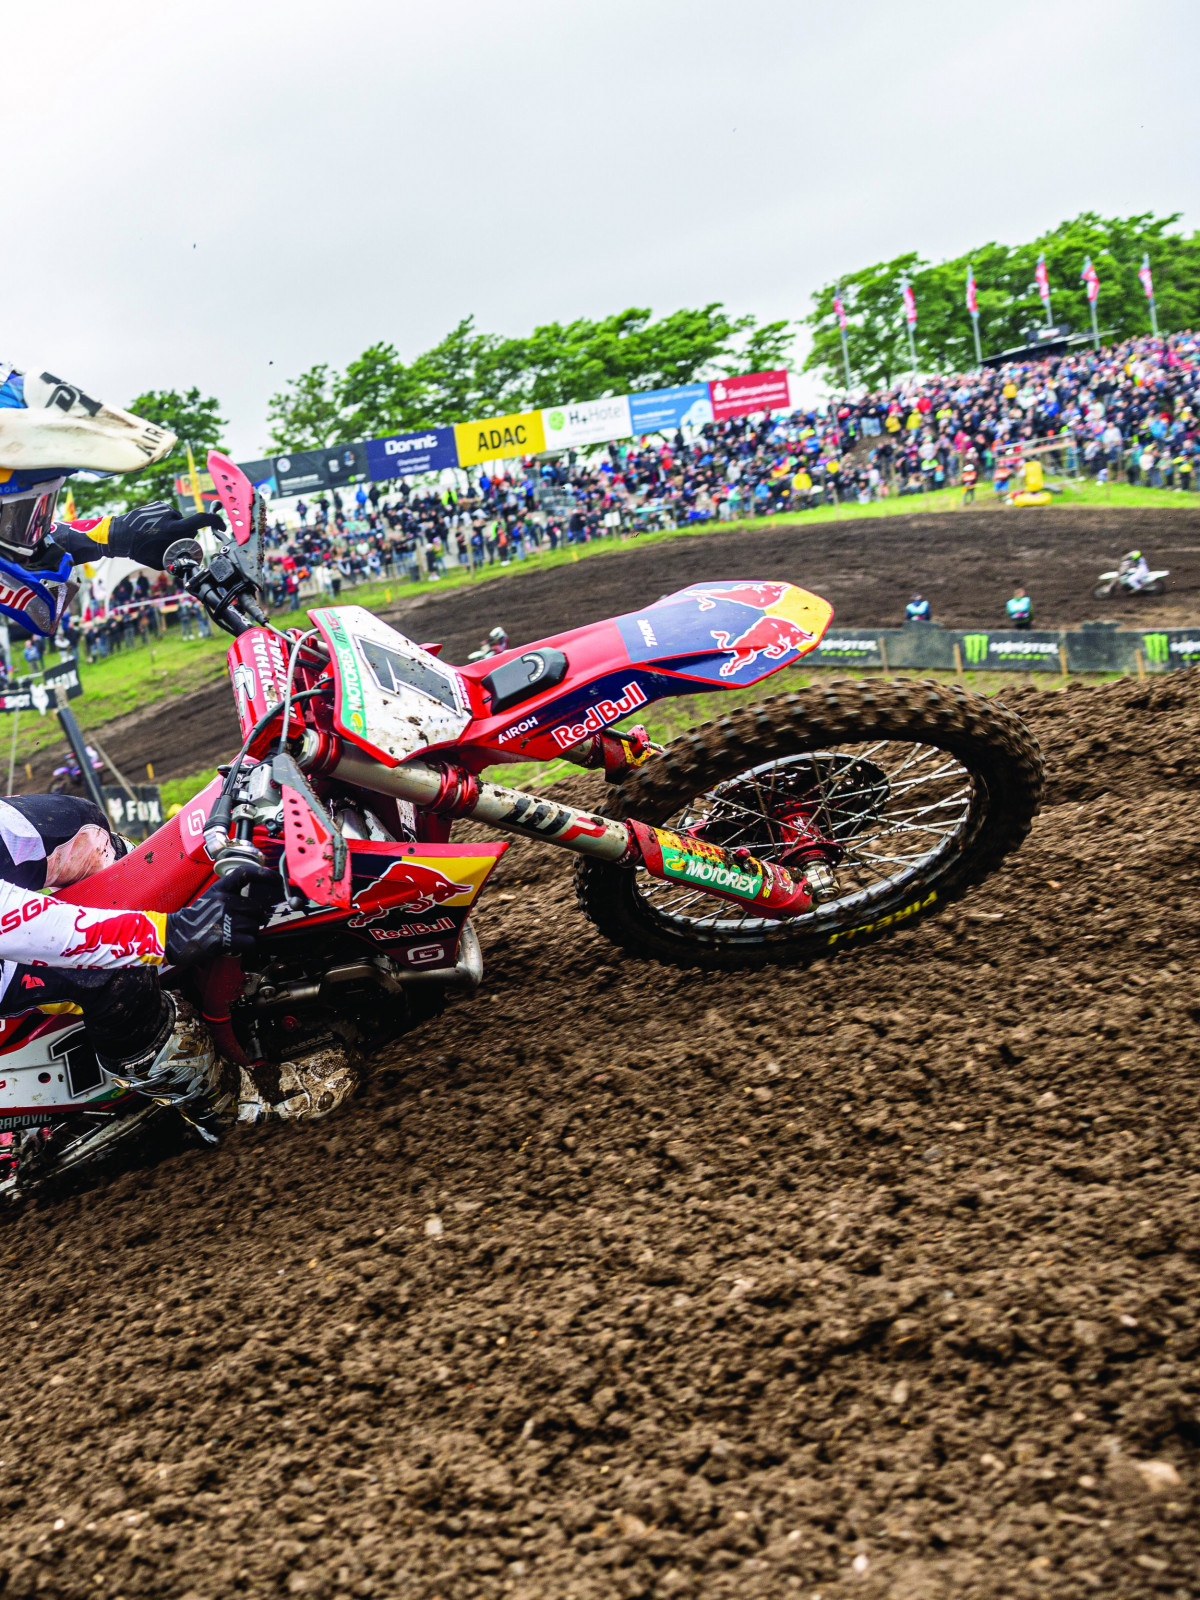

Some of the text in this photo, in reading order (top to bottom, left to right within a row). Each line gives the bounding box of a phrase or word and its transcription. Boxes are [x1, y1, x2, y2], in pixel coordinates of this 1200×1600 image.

[478, 425, 528, 452] ADAC
[636, 618, 659, 648] THOR
[336, 643, 363, 712] MOTOREX
[550, 680, 648, 750] Red Bull
[497, 716, 540, 745] AIROH
[125, 800, 162, 823] FOX
[686, 860, 759, 896] MOTOREX
[222, 913, 233, 947] THOR
[368, 916, 456, 941] Red Bull
